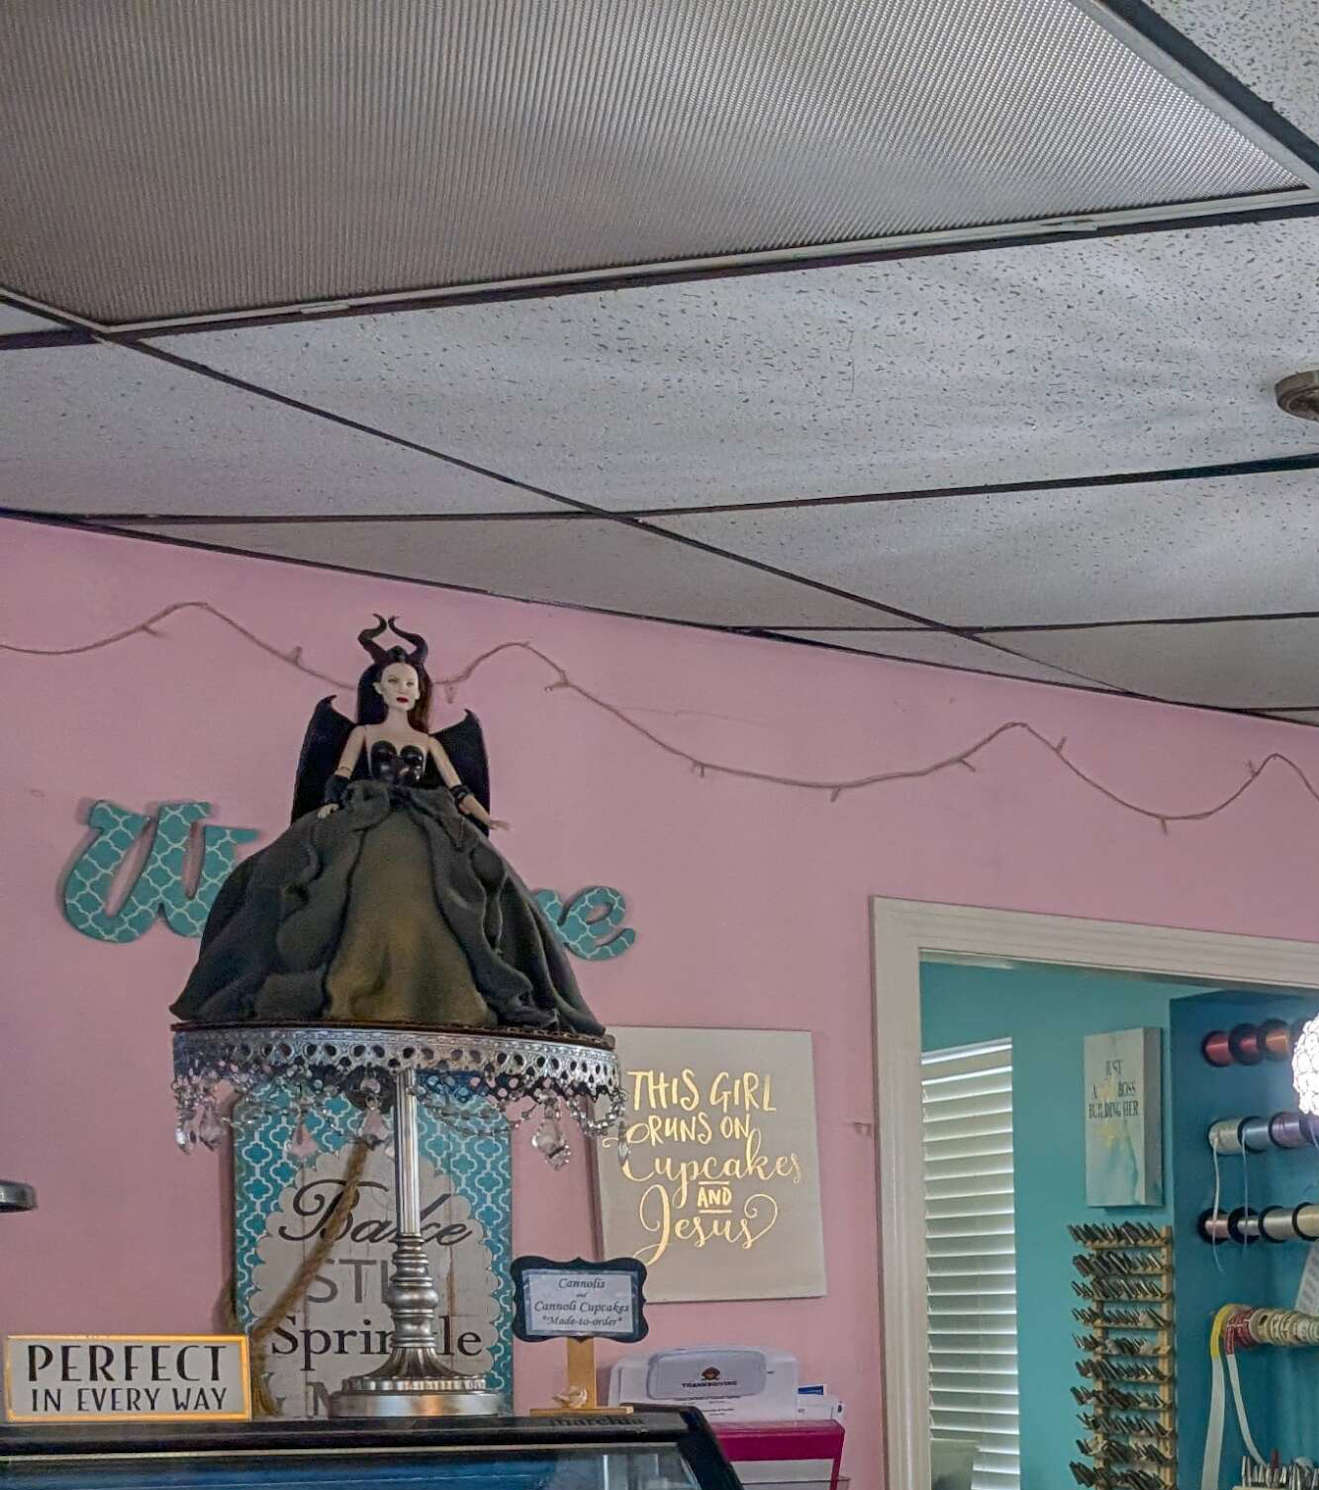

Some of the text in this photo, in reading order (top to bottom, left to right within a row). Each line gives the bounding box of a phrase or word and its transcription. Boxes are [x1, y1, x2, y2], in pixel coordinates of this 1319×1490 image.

[628, 1069, 776, 1112] THIS GIRL
[626, 1112, 751, 1146] RUNS ON
[622, 1128, 800, 1209] Cupcakes
[697, 1186, 732, 1208] AND
[633, 1184, 777, 1266] Jesus
[558, 1277, 606, 1289] Cannolis
[534, 1300, 630, 1314] Cannoli Cupcakes
[27, 1344, 227, 1382] PERFECT
[32, 1387, 227, 1412] IN EVERY WAY
